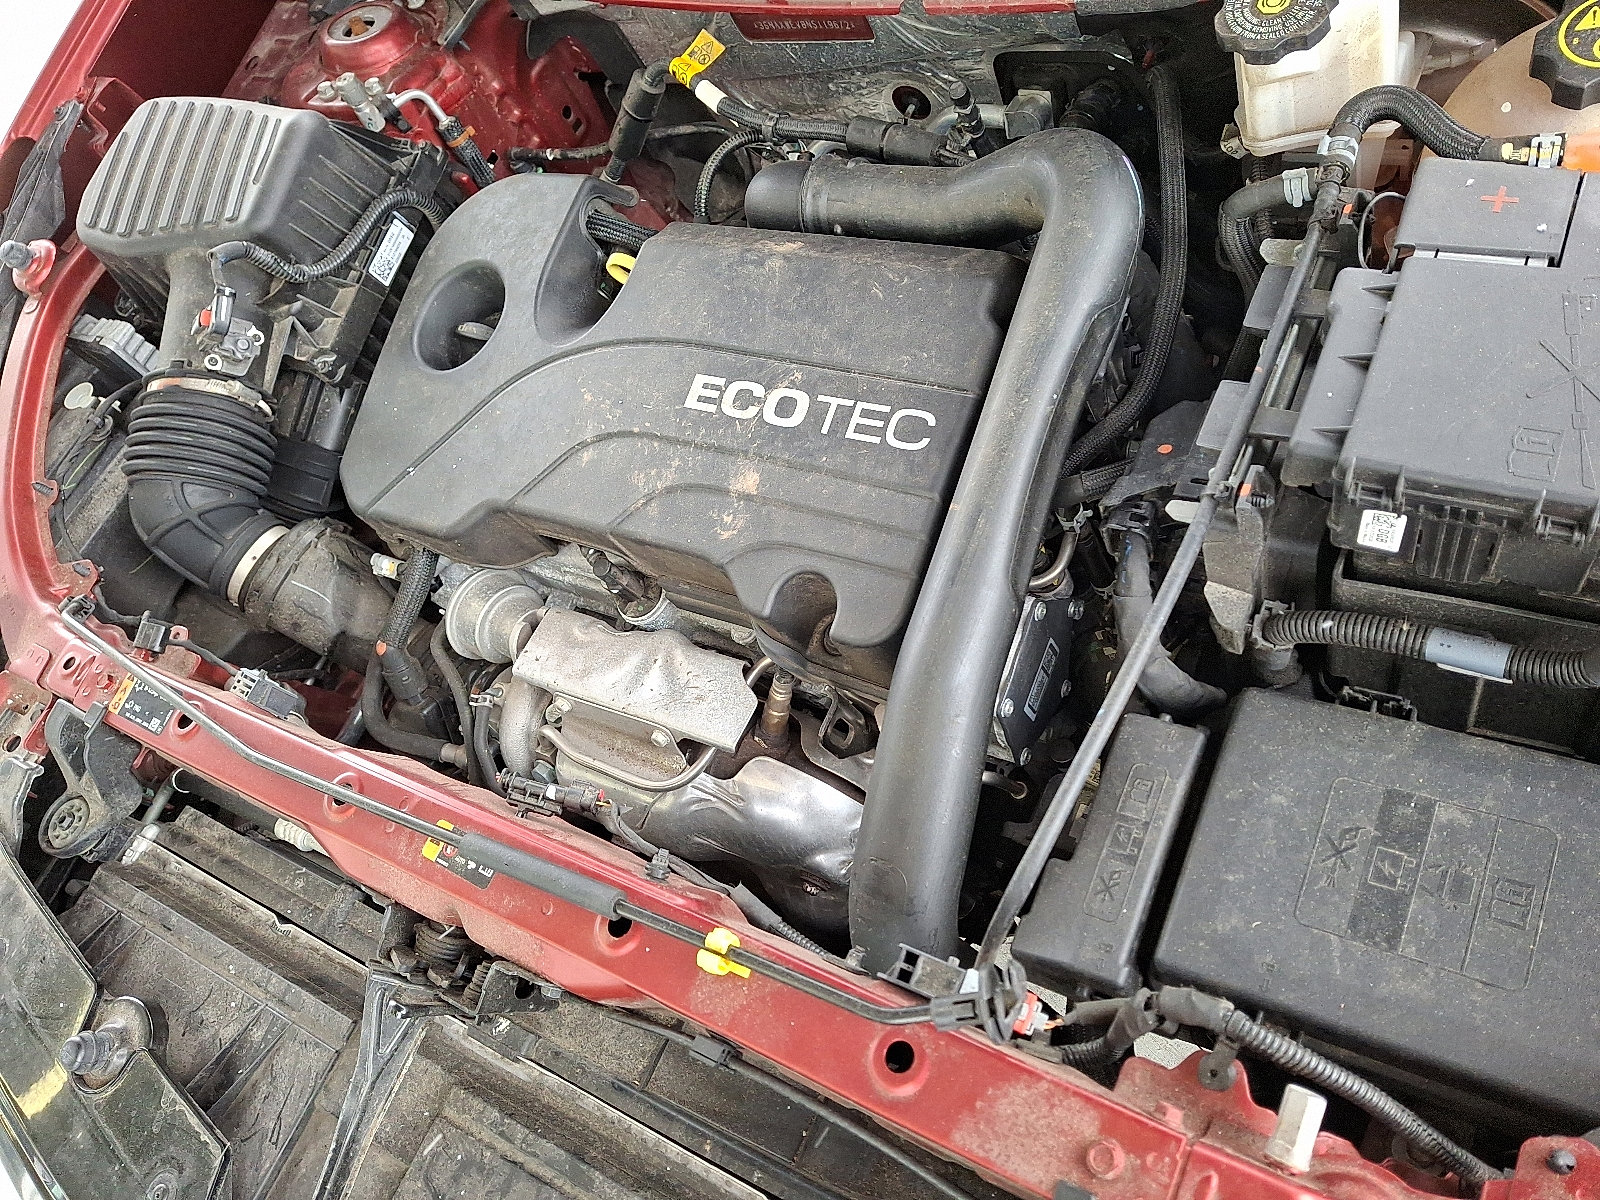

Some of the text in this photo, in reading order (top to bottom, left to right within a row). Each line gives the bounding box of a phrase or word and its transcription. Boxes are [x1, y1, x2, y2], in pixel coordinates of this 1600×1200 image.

[1262, 18, 1282, 27] CLEAN
[1282, 5, 1302, 21] FILLER
[1285, 17, 1298, 27] USE
[1261, 29, 1286, 40] SEALED
[683, 373, 937, 451] ECOTEC
